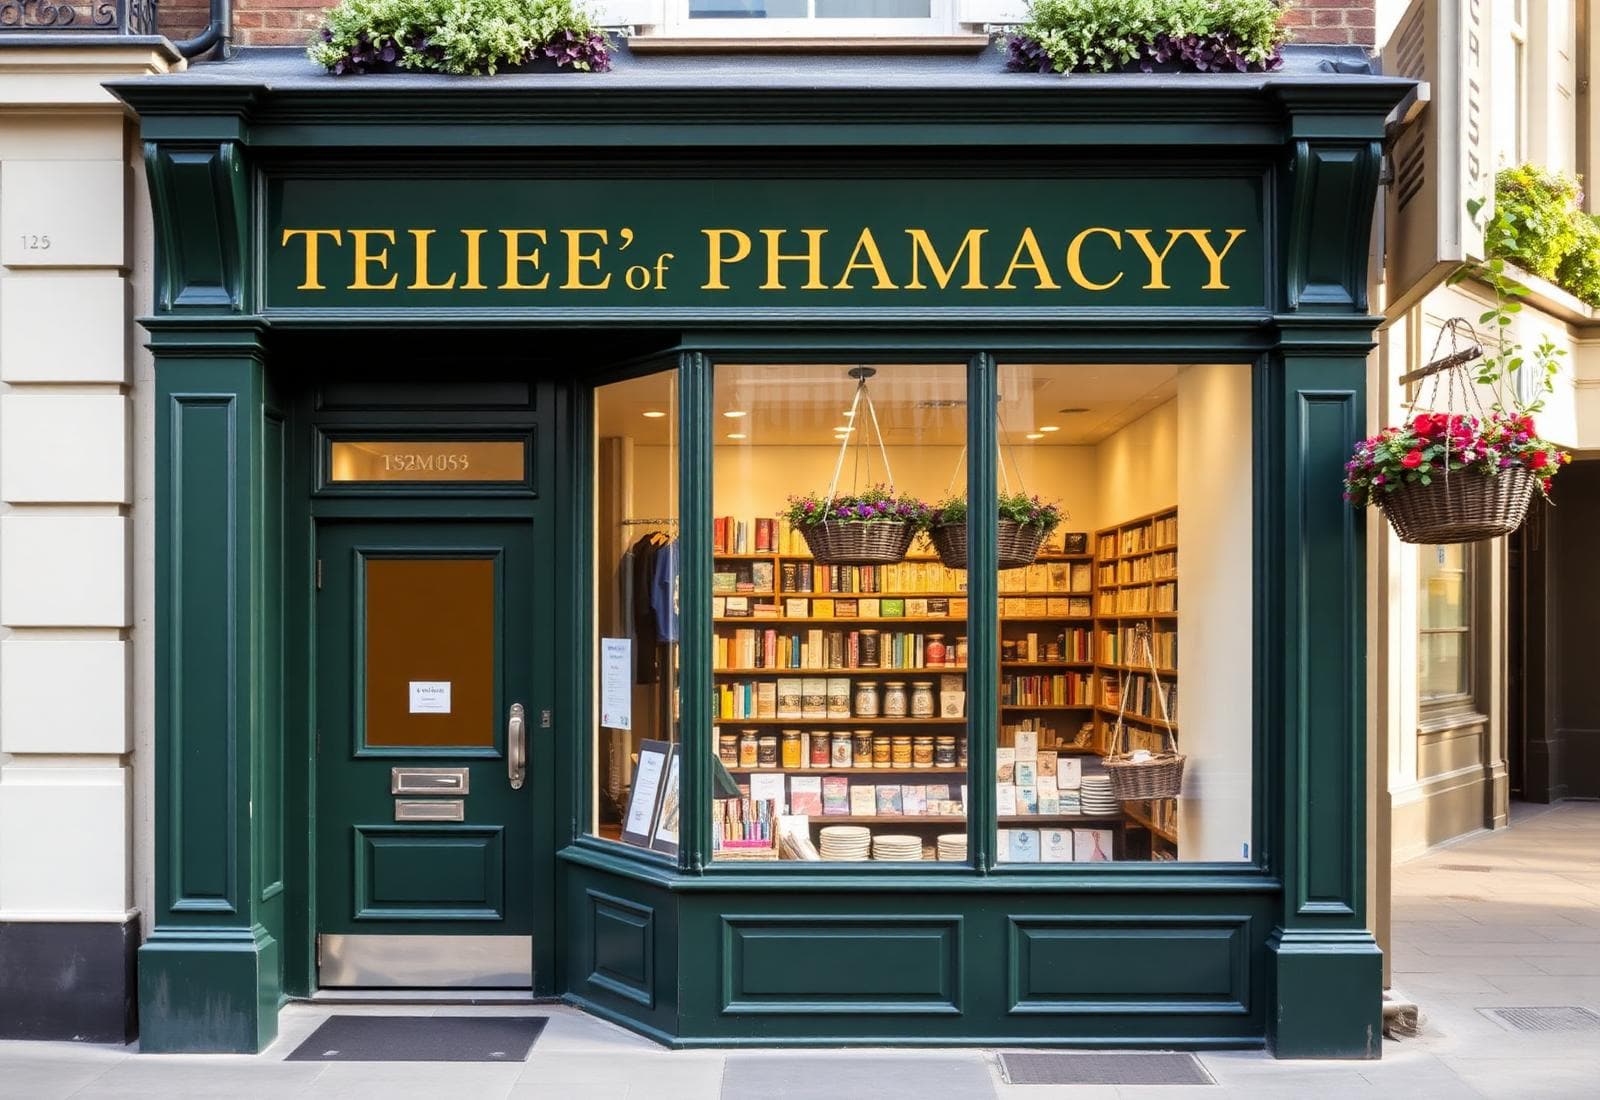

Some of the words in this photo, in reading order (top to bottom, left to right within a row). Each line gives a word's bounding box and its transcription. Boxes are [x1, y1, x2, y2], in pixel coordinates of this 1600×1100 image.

[20, 234, 51, 250] 125
[624, 253, 674, 291] of
[700, 226, 1247, 292] PHAMACYY
